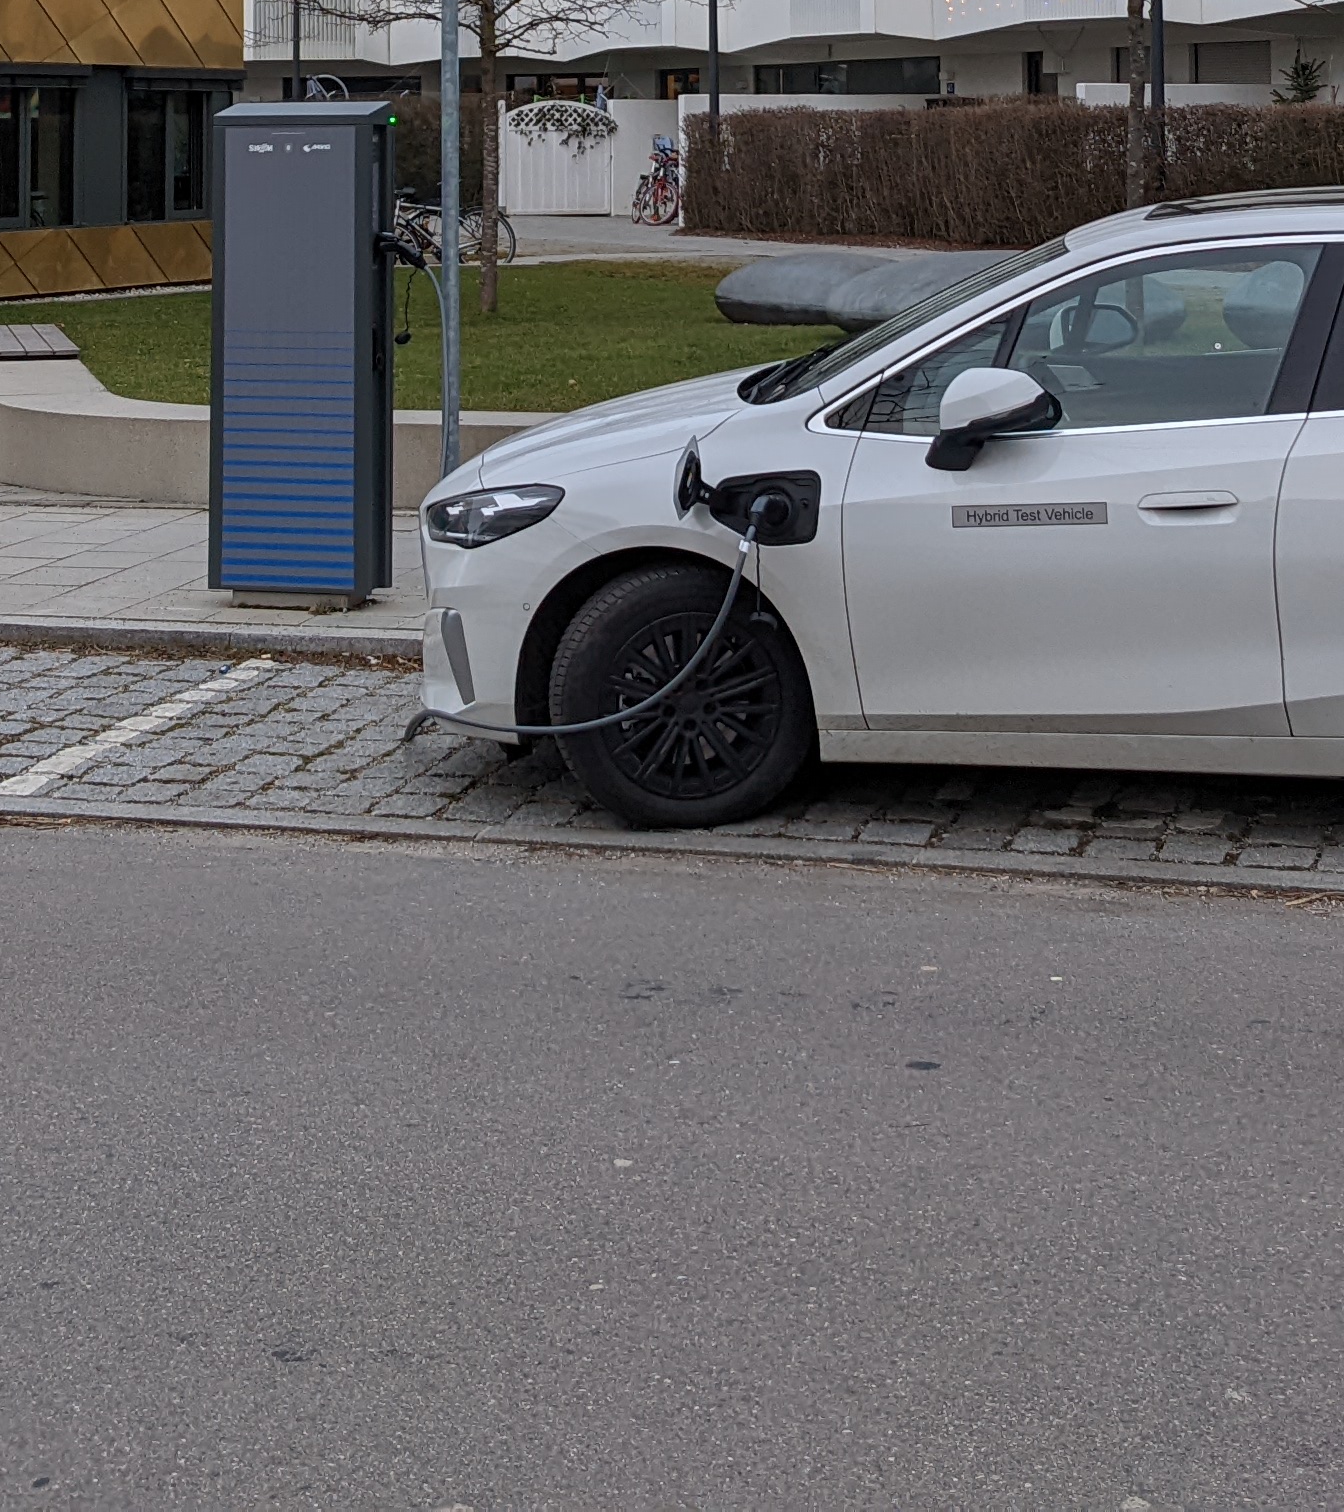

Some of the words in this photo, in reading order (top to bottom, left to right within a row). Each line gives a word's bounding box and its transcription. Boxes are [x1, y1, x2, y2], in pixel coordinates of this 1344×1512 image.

[966, 509, 1009, 525] Hybrid
[1013, 508, 1041, 521] Test
[1044, 507, 1094, 520] Vehicle
